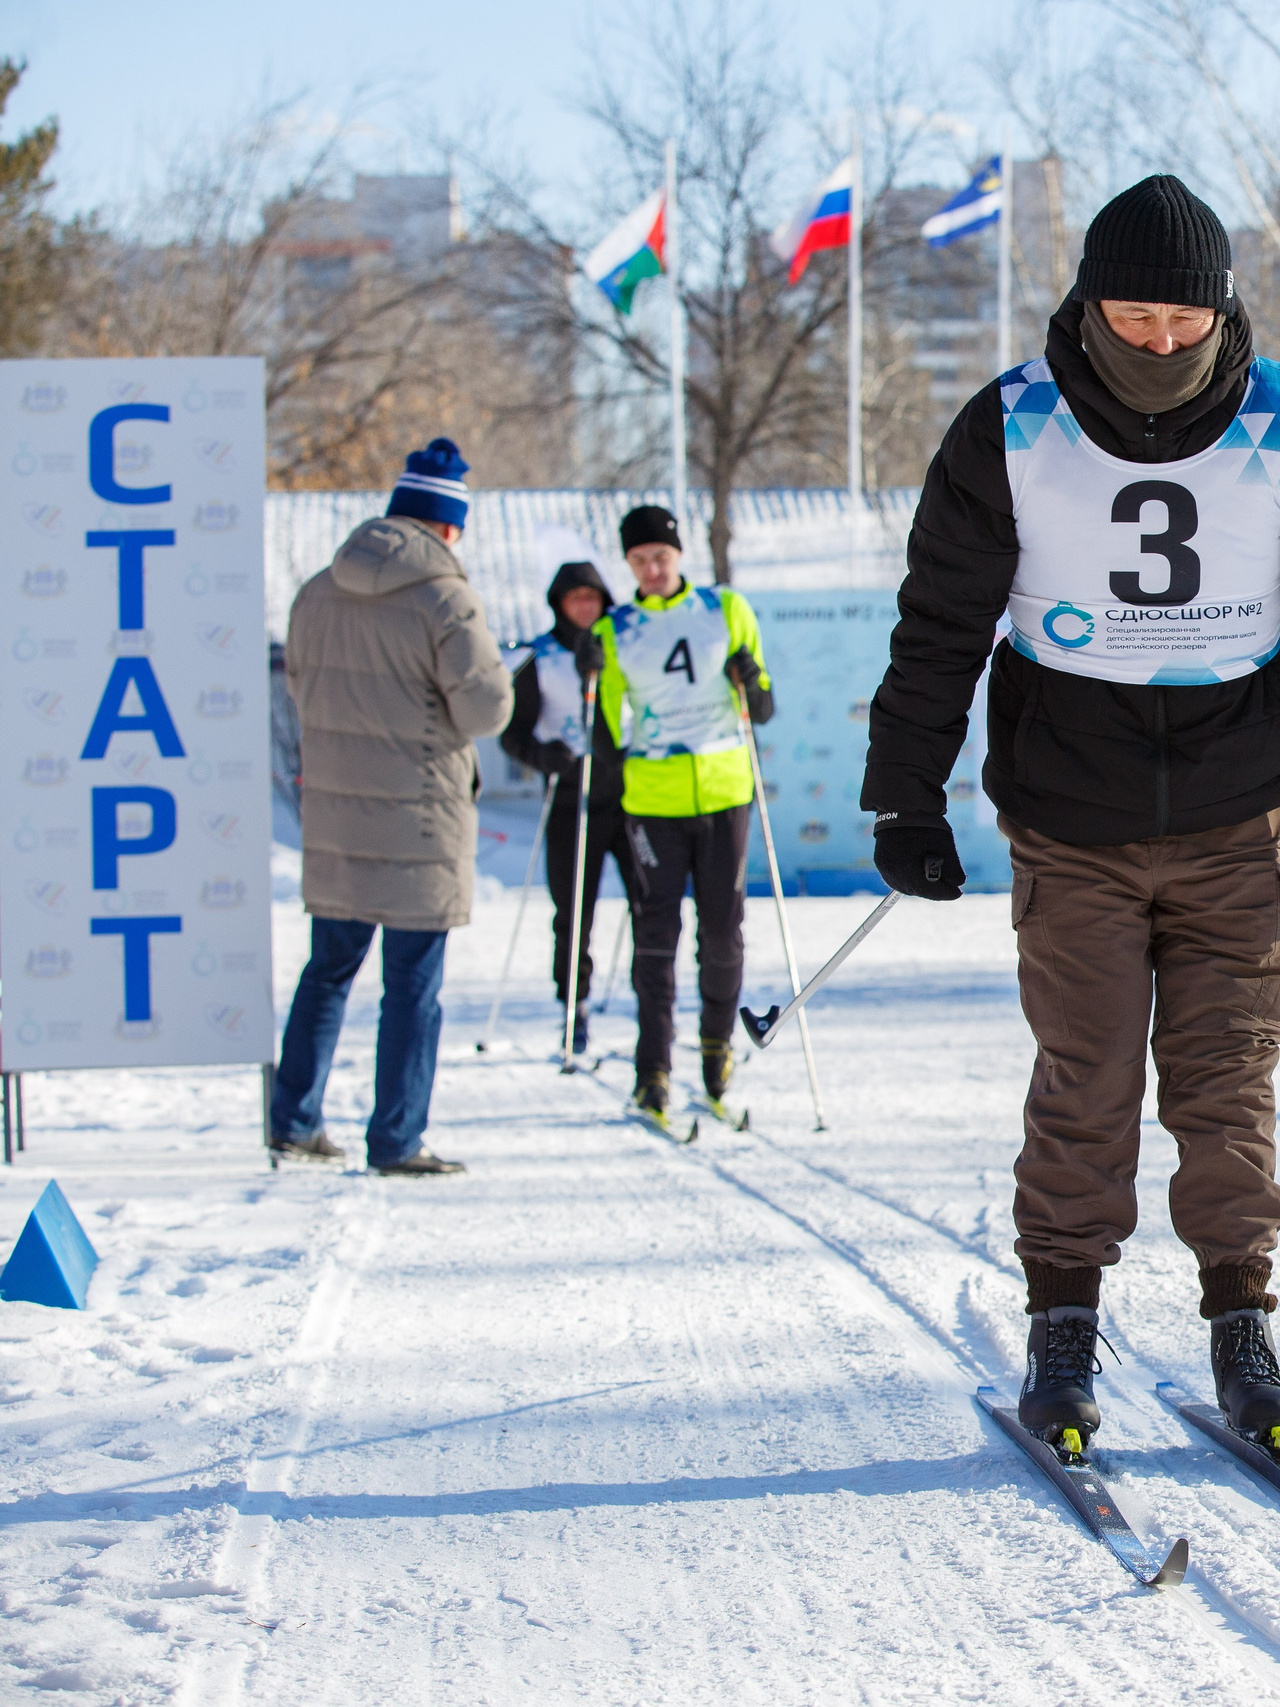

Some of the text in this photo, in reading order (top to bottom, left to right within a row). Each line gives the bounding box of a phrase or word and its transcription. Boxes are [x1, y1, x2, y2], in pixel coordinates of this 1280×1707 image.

[1109, 480, 1201, 606] 3
[1105, 602, 1262, 623] СДЮСШОР №2
[1106, 626, 1201, 634] Специализированная
[1193, 633, 1239, 642] спортивная
[1239, 631, 1257, 639] школа
[664, 637, 695, 684] 4
[1171, 643, 1207, 651] резерва
[80, 402, 187, 1022] СТАРТ
[1026, 1351, 1038, 1394] NORDWAY
